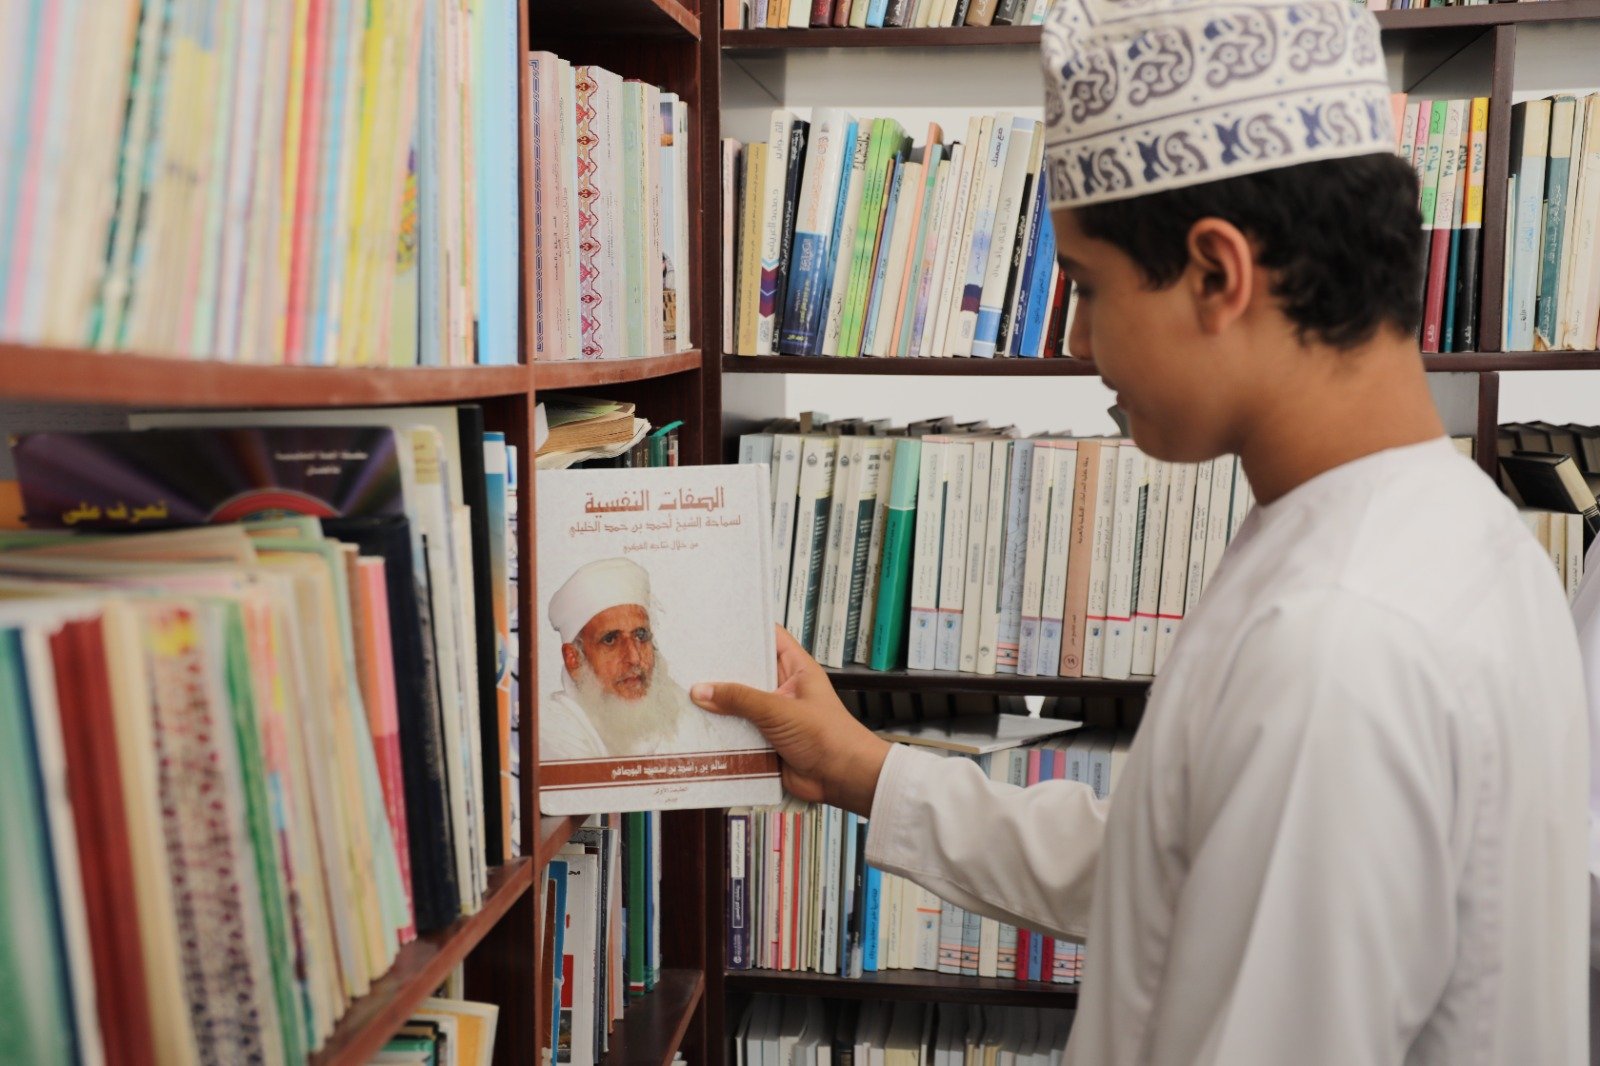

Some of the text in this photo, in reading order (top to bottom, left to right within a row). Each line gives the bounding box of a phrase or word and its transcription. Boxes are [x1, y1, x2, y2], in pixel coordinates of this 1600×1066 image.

[585, 486, 724, 519] الصفات النفسية
[568, 514, 741, 538] لسماحة الشيخ أحمد بن حمد الخليلي
[643, 765, 667, 776] سعيد
[666, 766, 677, 776] بن
[678, 761, 698, 774] راشد
[700, 764, 709, 773] بن
[710, 759, 727, 772] سالم
